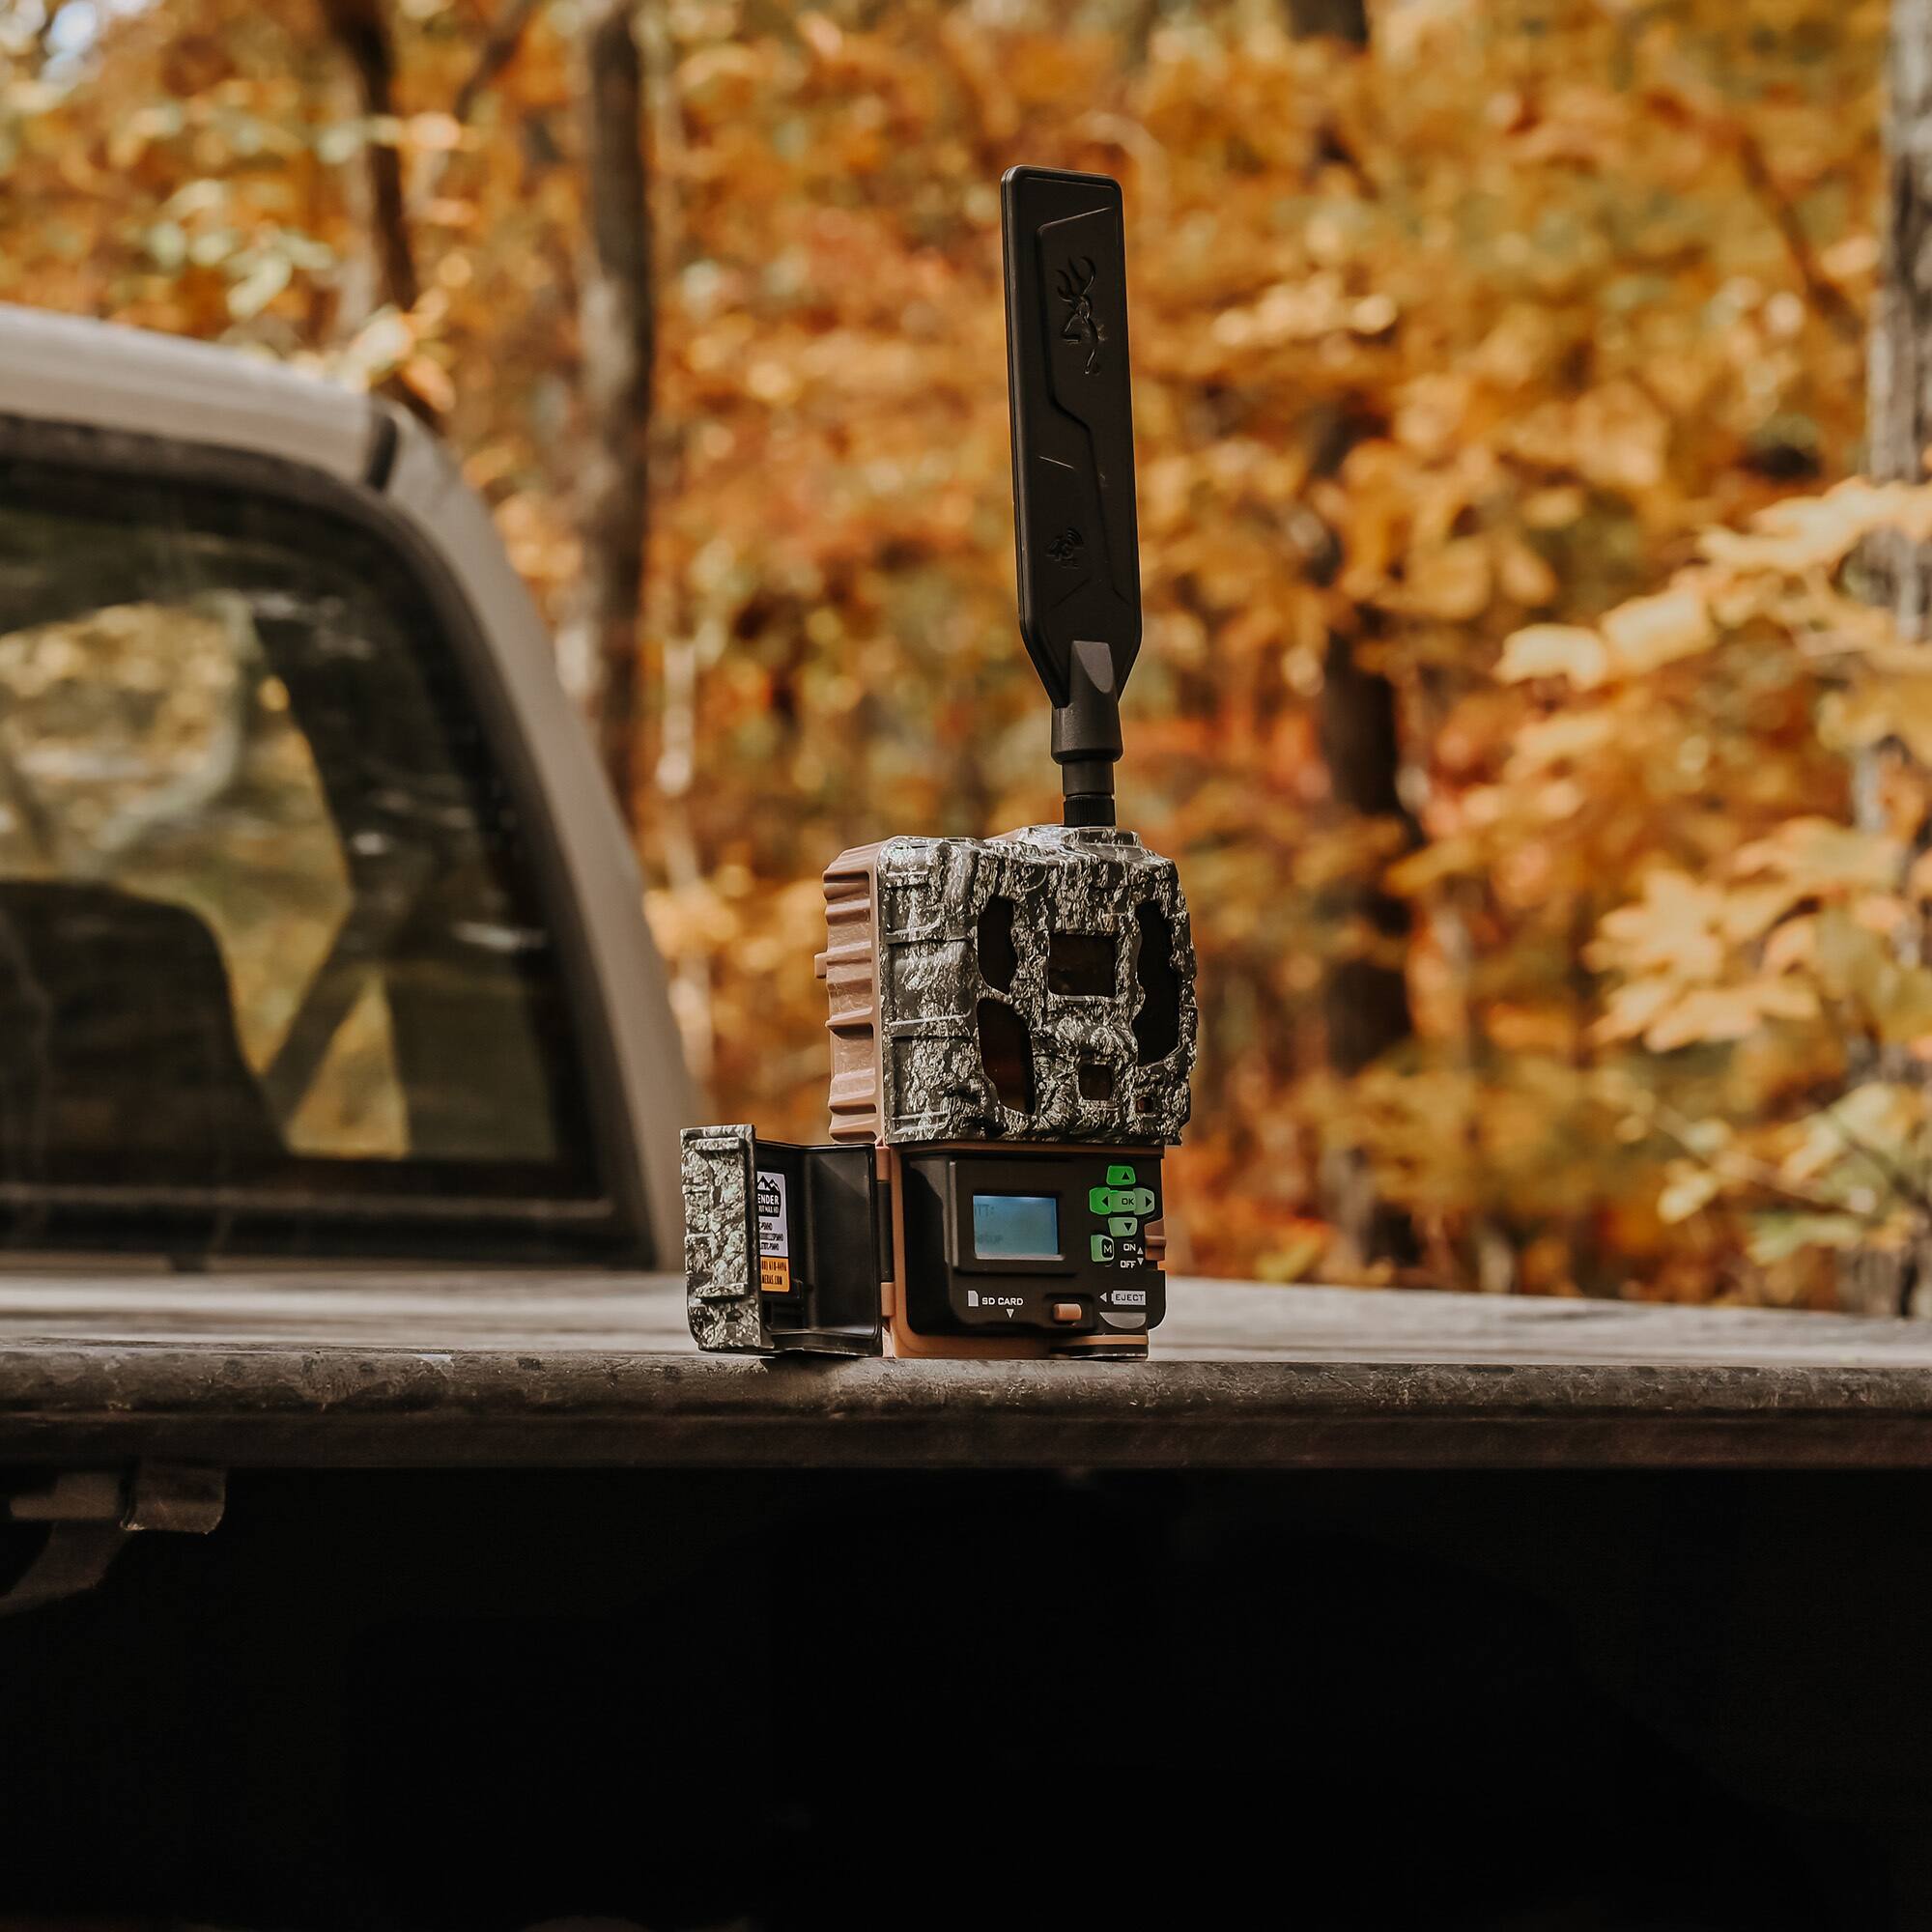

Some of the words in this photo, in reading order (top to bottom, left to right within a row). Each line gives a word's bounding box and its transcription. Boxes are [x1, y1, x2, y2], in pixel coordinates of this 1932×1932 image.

[1103, 1244, 1113, 1254] M
[1123, 1243, 1136, 1252] ON
[1120, 1260, 1136, 1268] OFF
[981, 1296, 996, 1306] SD
[998, 1296, 1024, 1306] CARD
[1115, 1293, 1145, 1302] EJECT
